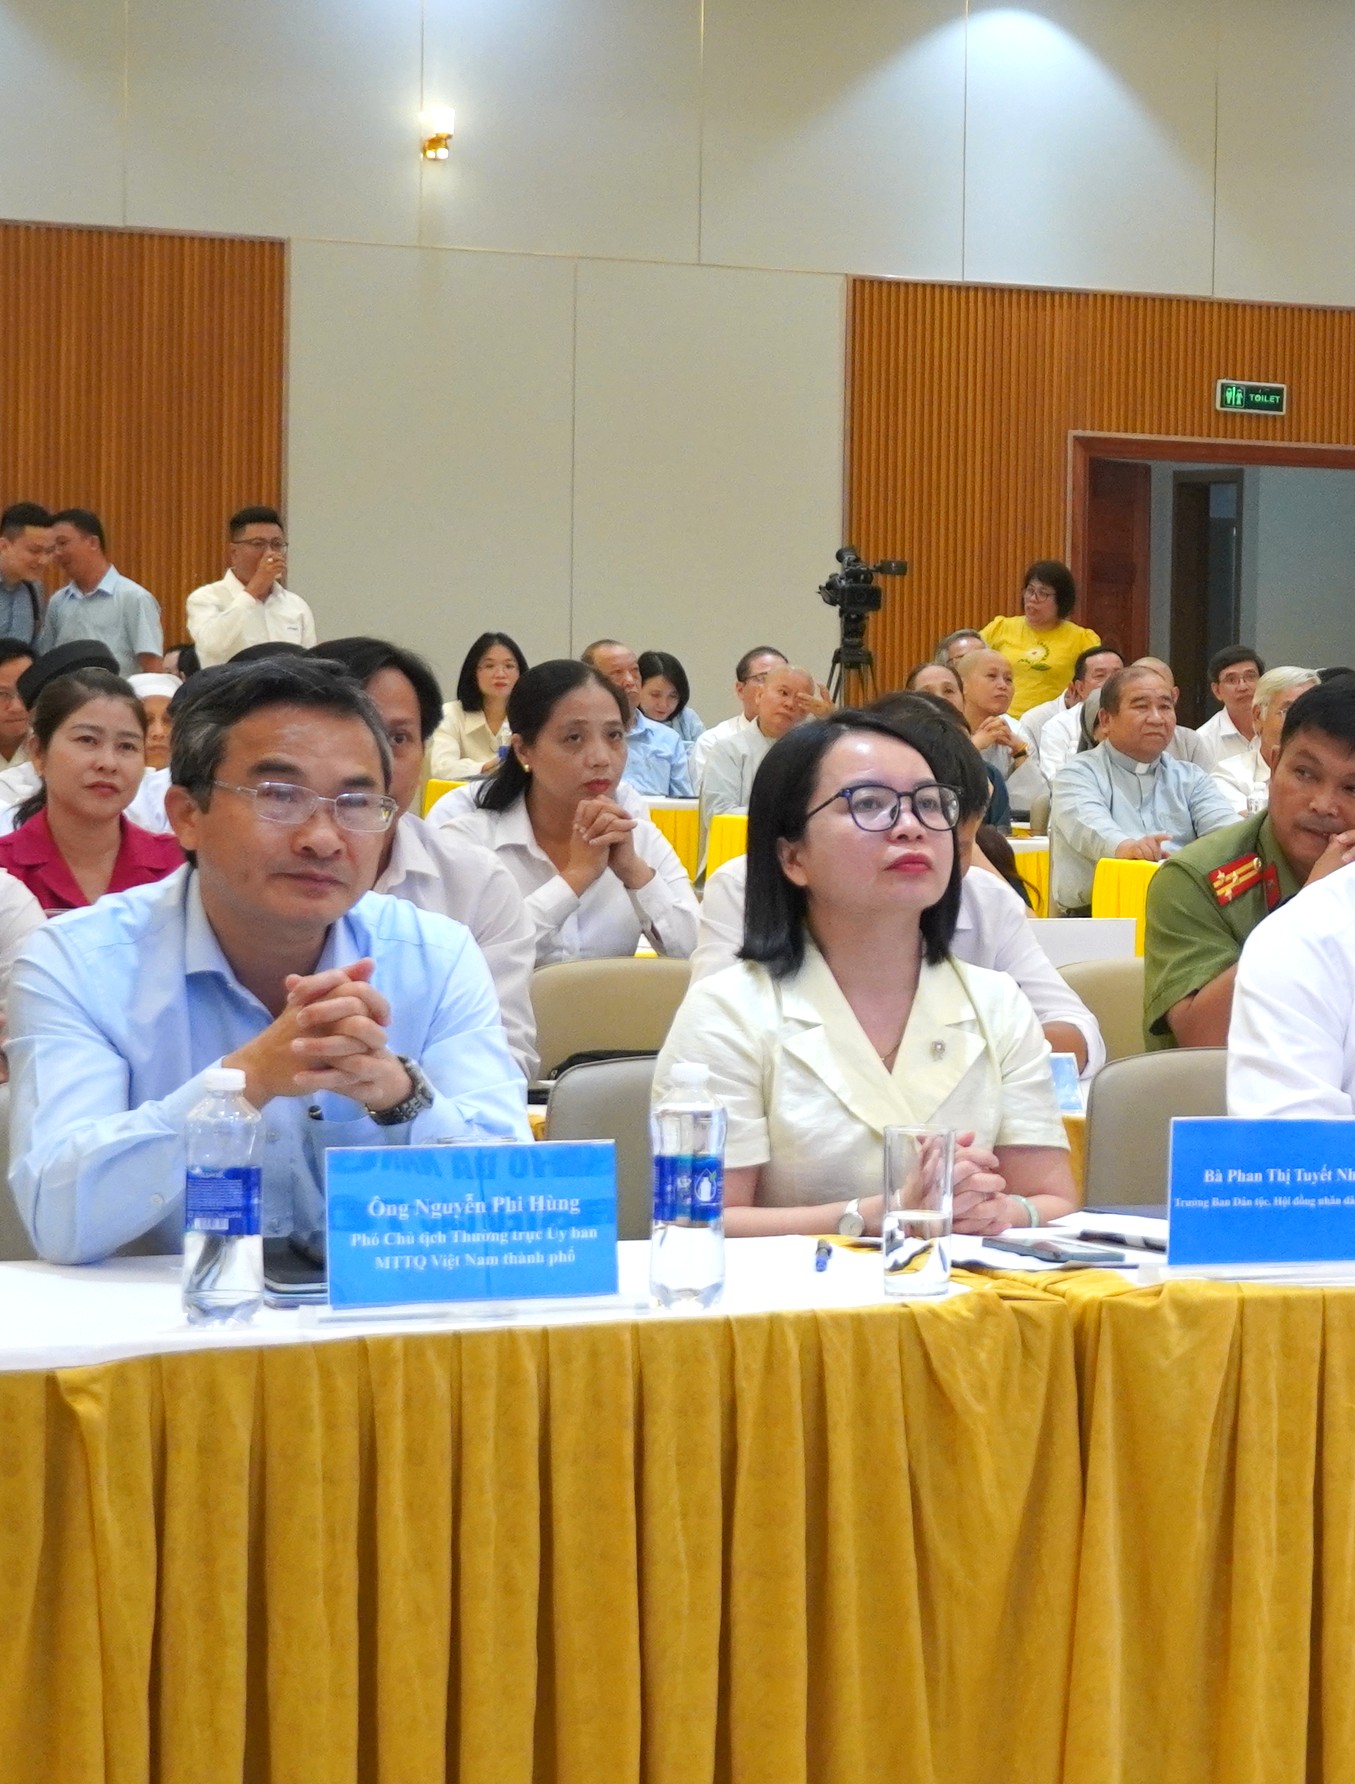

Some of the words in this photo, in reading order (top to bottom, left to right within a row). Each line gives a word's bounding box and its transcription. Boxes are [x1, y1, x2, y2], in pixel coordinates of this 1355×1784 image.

[1249, 393, 1281, 403] TOILET
[1203, 1168, 1223, 1183] Bà
[1227, 1168, 1263, 1183] Phan
[1266, 1168, 1291, 1184] Thị
[1294, 1164, 1333, 1184] Tuyết
[368, 1195, 410, 1220] Ông
[415, 1193, 486, 1219] Nguyễn
[492, 1195, 523, 1213] Phi
[529, 1194, 581, 1215] Hùng
[351, 1232, 380, 1247] Phó
[383, 1231, 415, 1245] Chủ
[418, 1230, 447, 1247] tịch
[452, 1228, 508, 1245] Thường
[571, 1227, 598, 1239] ban
[375, 1255, 427, 1271] MTTQ
[430, 1253, 460, 1270] Việt
[465, 1253, 499, 1266] Nam
[503, 1251, 545, 1265] thành
[549, 1246, 576, 1267] phố
